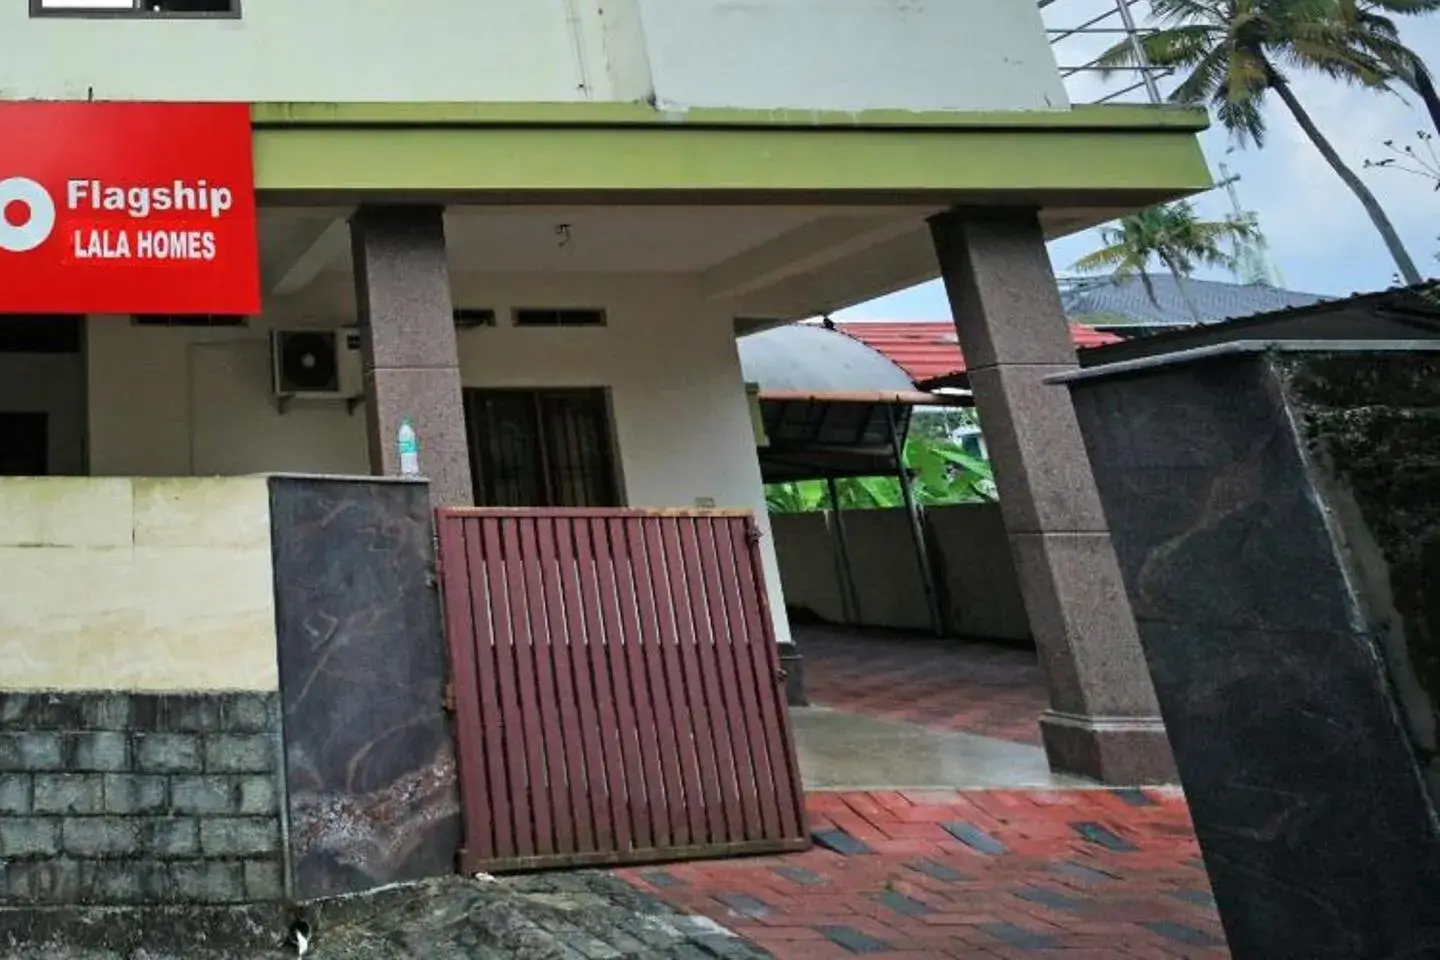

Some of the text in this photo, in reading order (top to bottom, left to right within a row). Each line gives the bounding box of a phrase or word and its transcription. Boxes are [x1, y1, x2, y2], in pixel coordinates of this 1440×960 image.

[67, 179, 232, 218] Flagship
[74, 229, 216, 260] LALA HOMES
